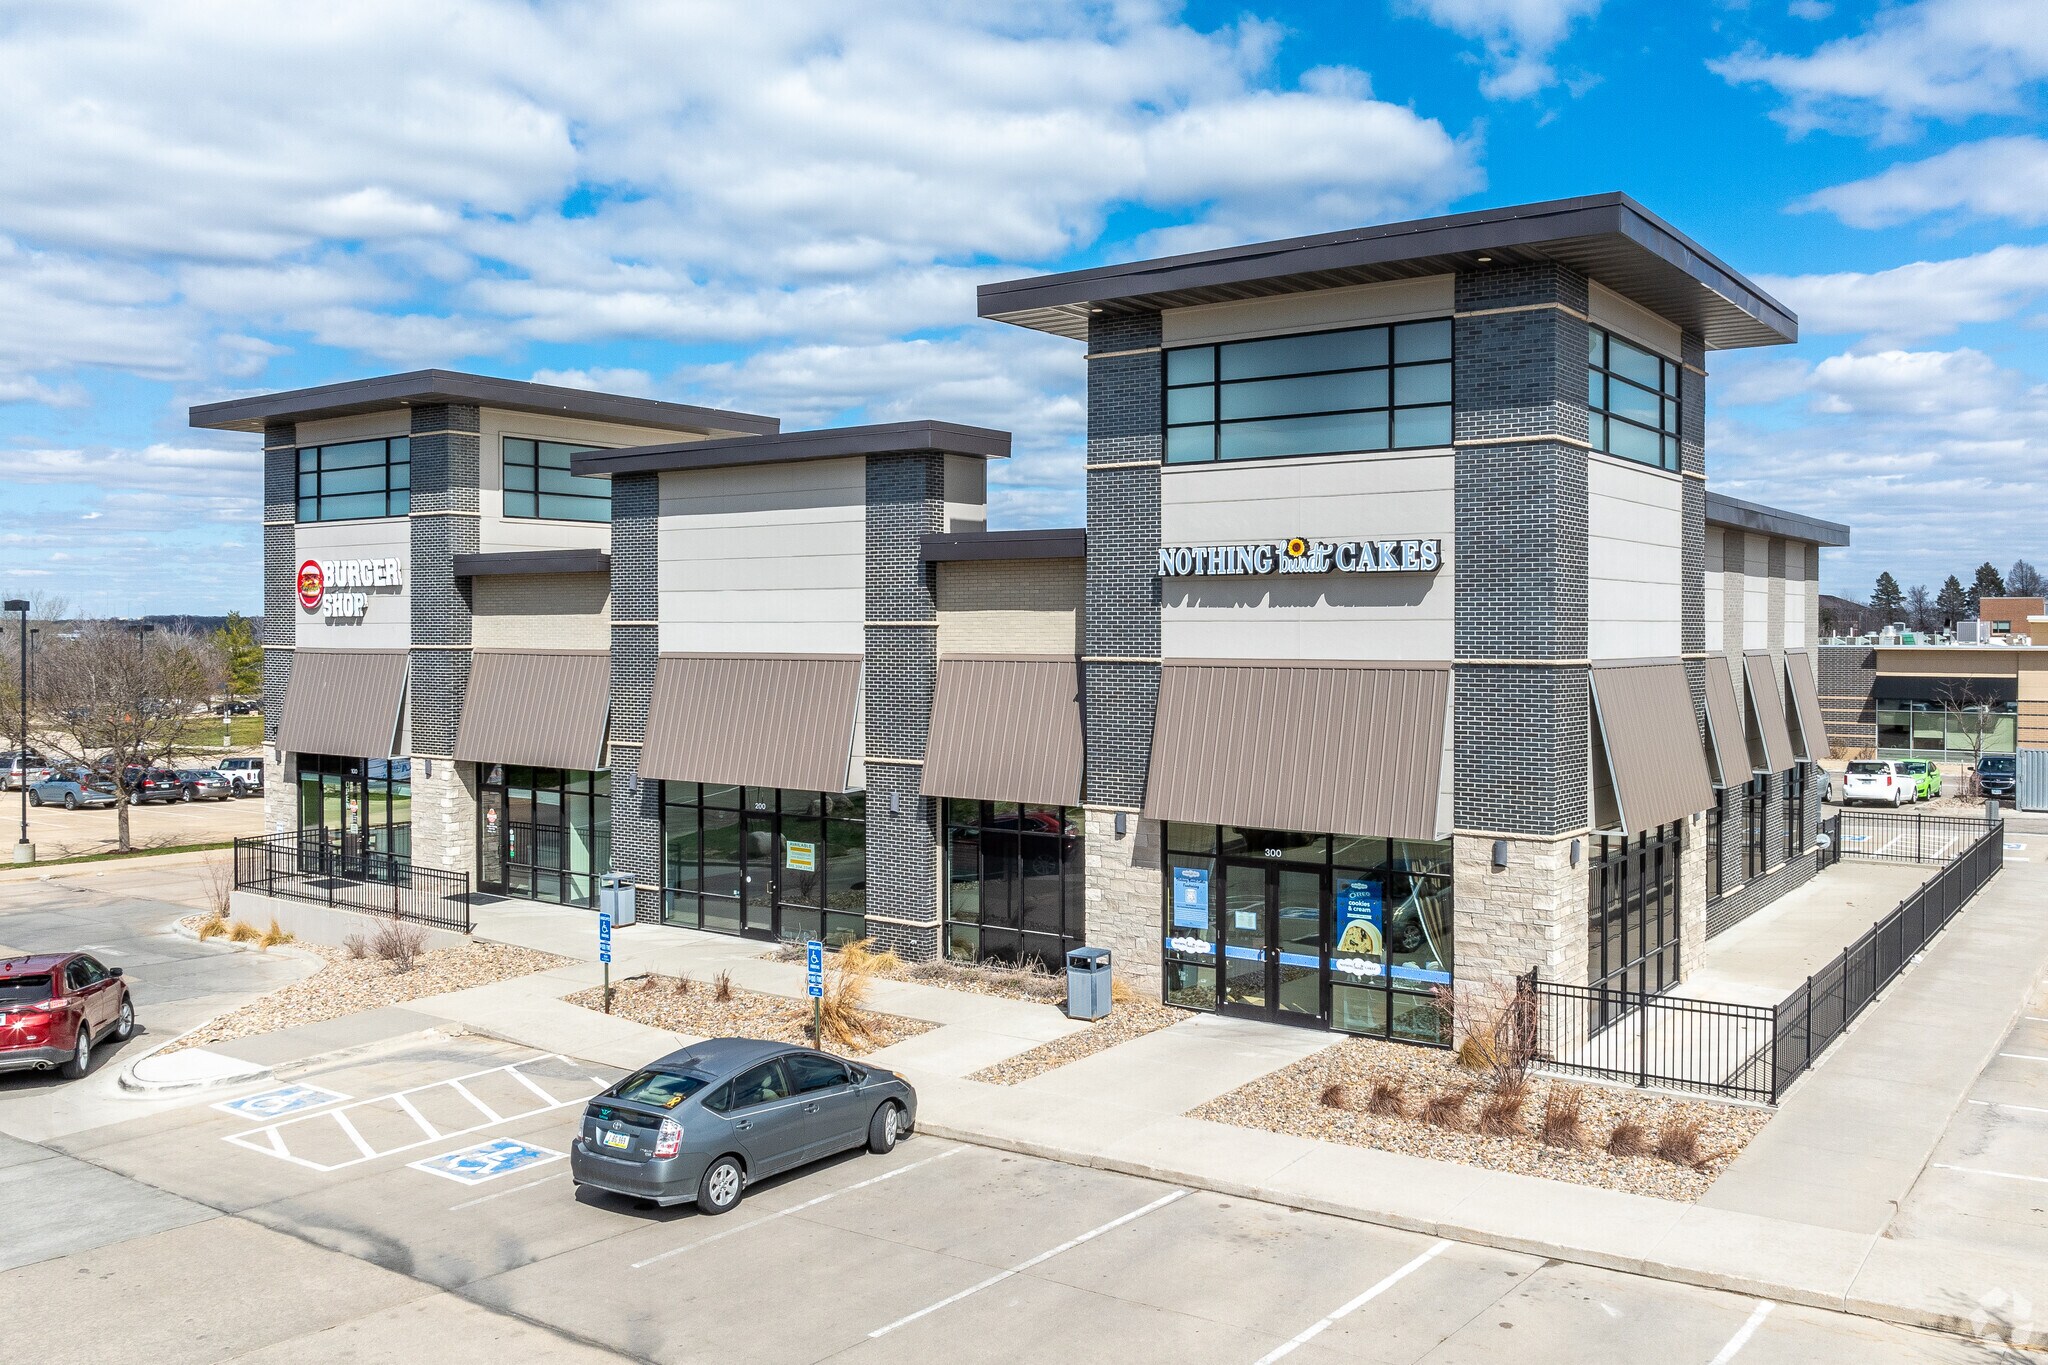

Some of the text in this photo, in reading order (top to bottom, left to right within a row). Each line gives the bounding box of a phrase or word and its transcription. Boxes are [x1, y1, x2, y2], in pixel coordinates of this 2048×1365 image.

[1158, 539, 1440, 576] NOTHING bundt CAKES
[322, 558, 402, 587] BURGER
[322, 592, 367, 618] SHOP
[754, 802, 767, 810] 200
[1264, 847, 1282, 858] 300
[1348, 900, 1371, 908] cookies
